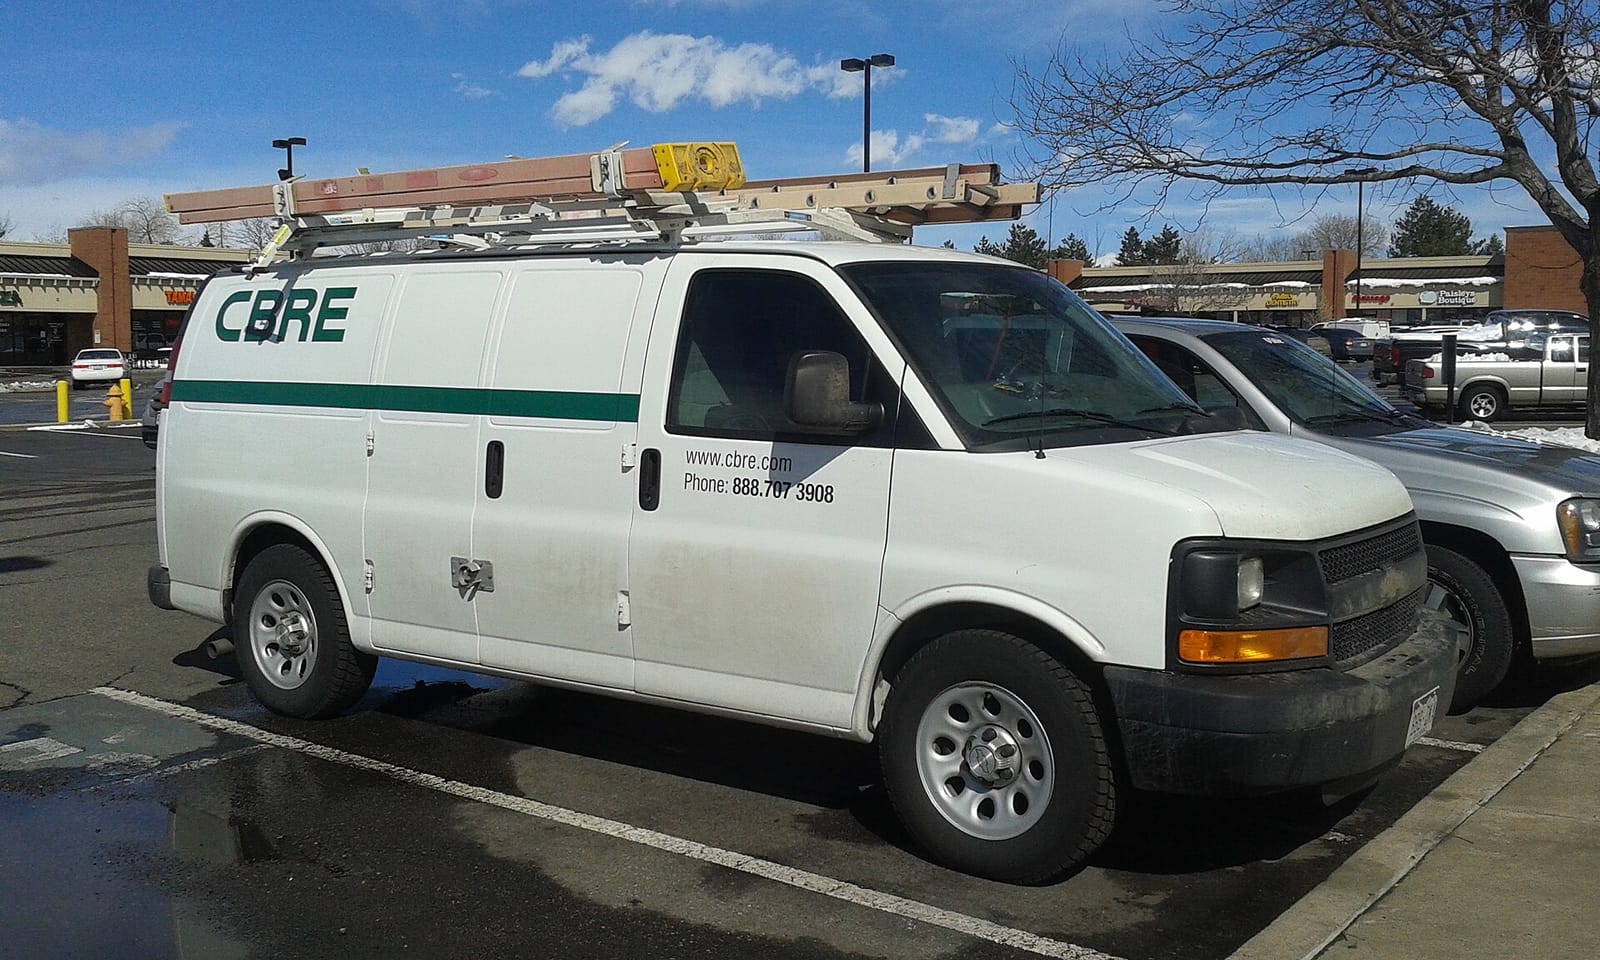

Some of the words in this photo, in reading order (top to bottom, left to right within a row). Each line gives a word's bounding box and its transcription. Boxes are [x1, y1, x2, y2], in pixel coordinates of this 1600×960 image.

[164, 290, 196, 304] TAMA
[215, 287, 358, 342] CBRE
[685, 449, 793, 472] www.cbre.com
[683, 472, 729, 494] Phone:
[732, 477, 792, 500] 888.707
[795, 482, 835, 504] 3908
